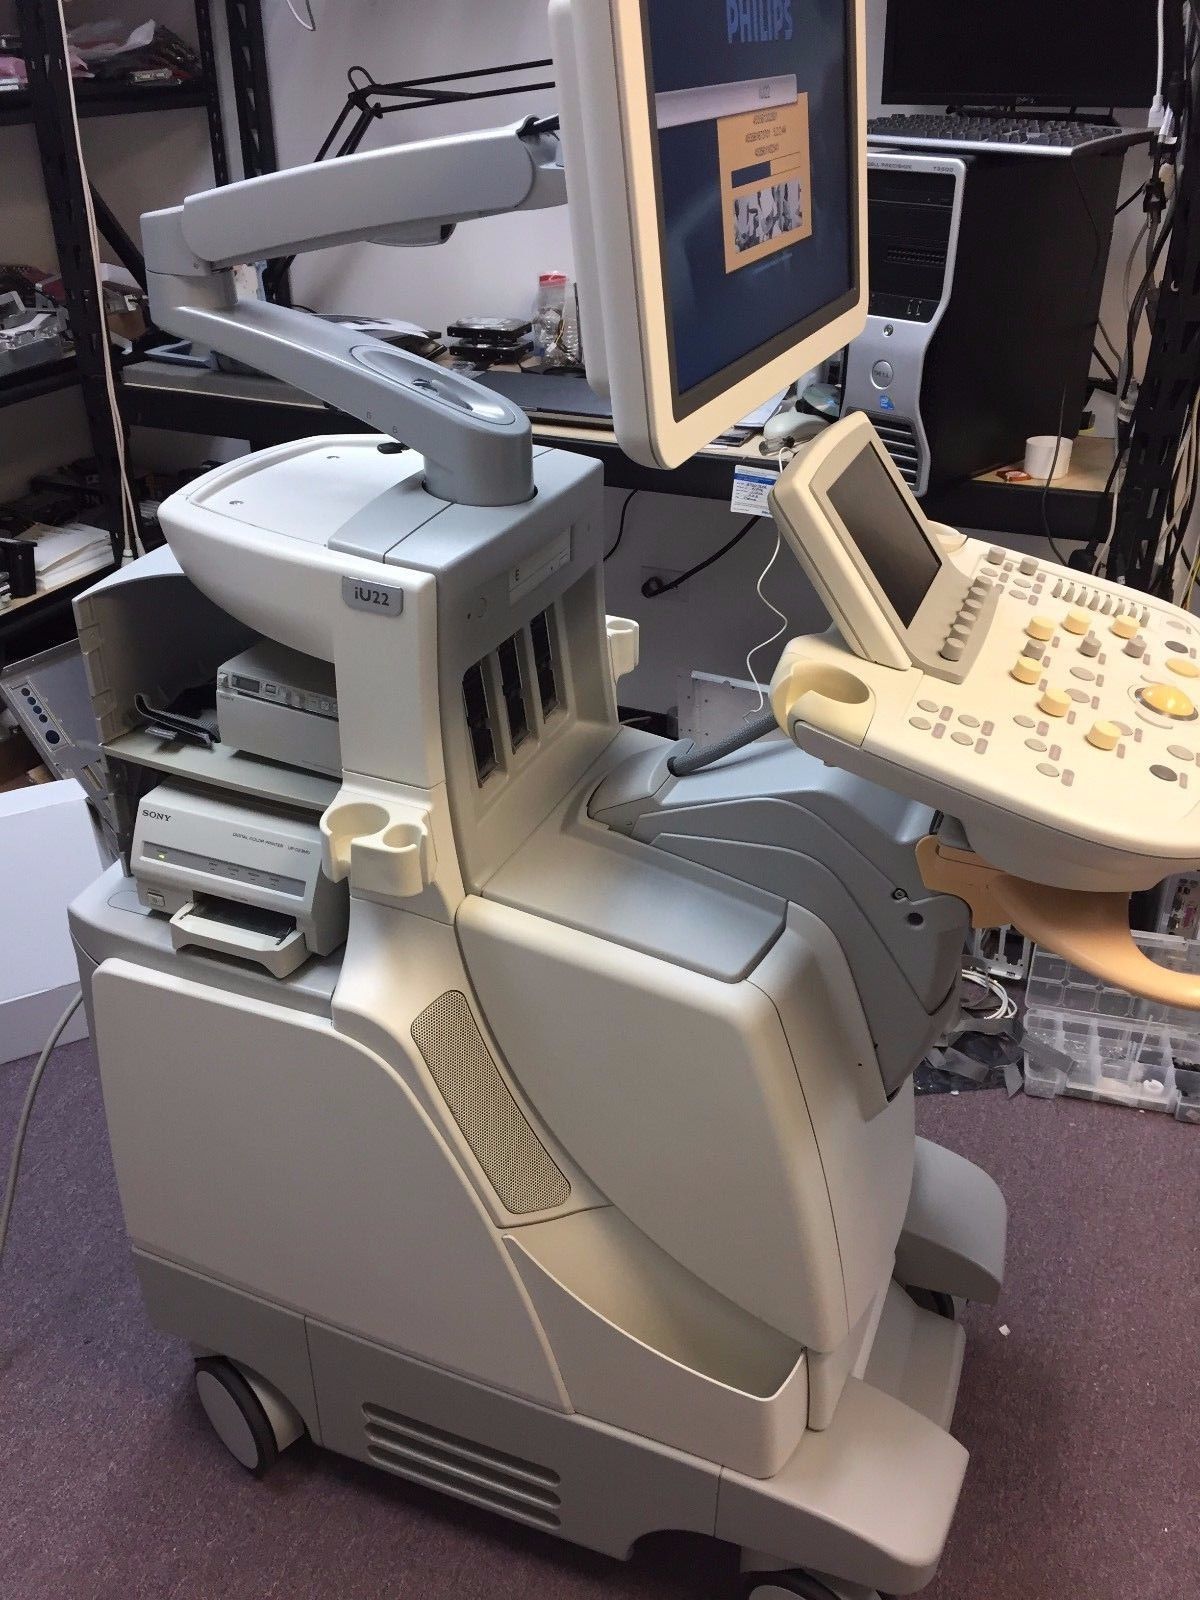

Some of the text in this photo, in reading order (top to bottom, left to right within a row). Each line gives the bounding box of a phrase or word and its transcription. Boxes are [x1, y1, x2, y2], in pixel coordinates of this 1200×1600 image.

[726, 0, 792, 43] PHILIPS
[354, 586, 390, 607] iU22
[142, 809, 172, 822] SONY
